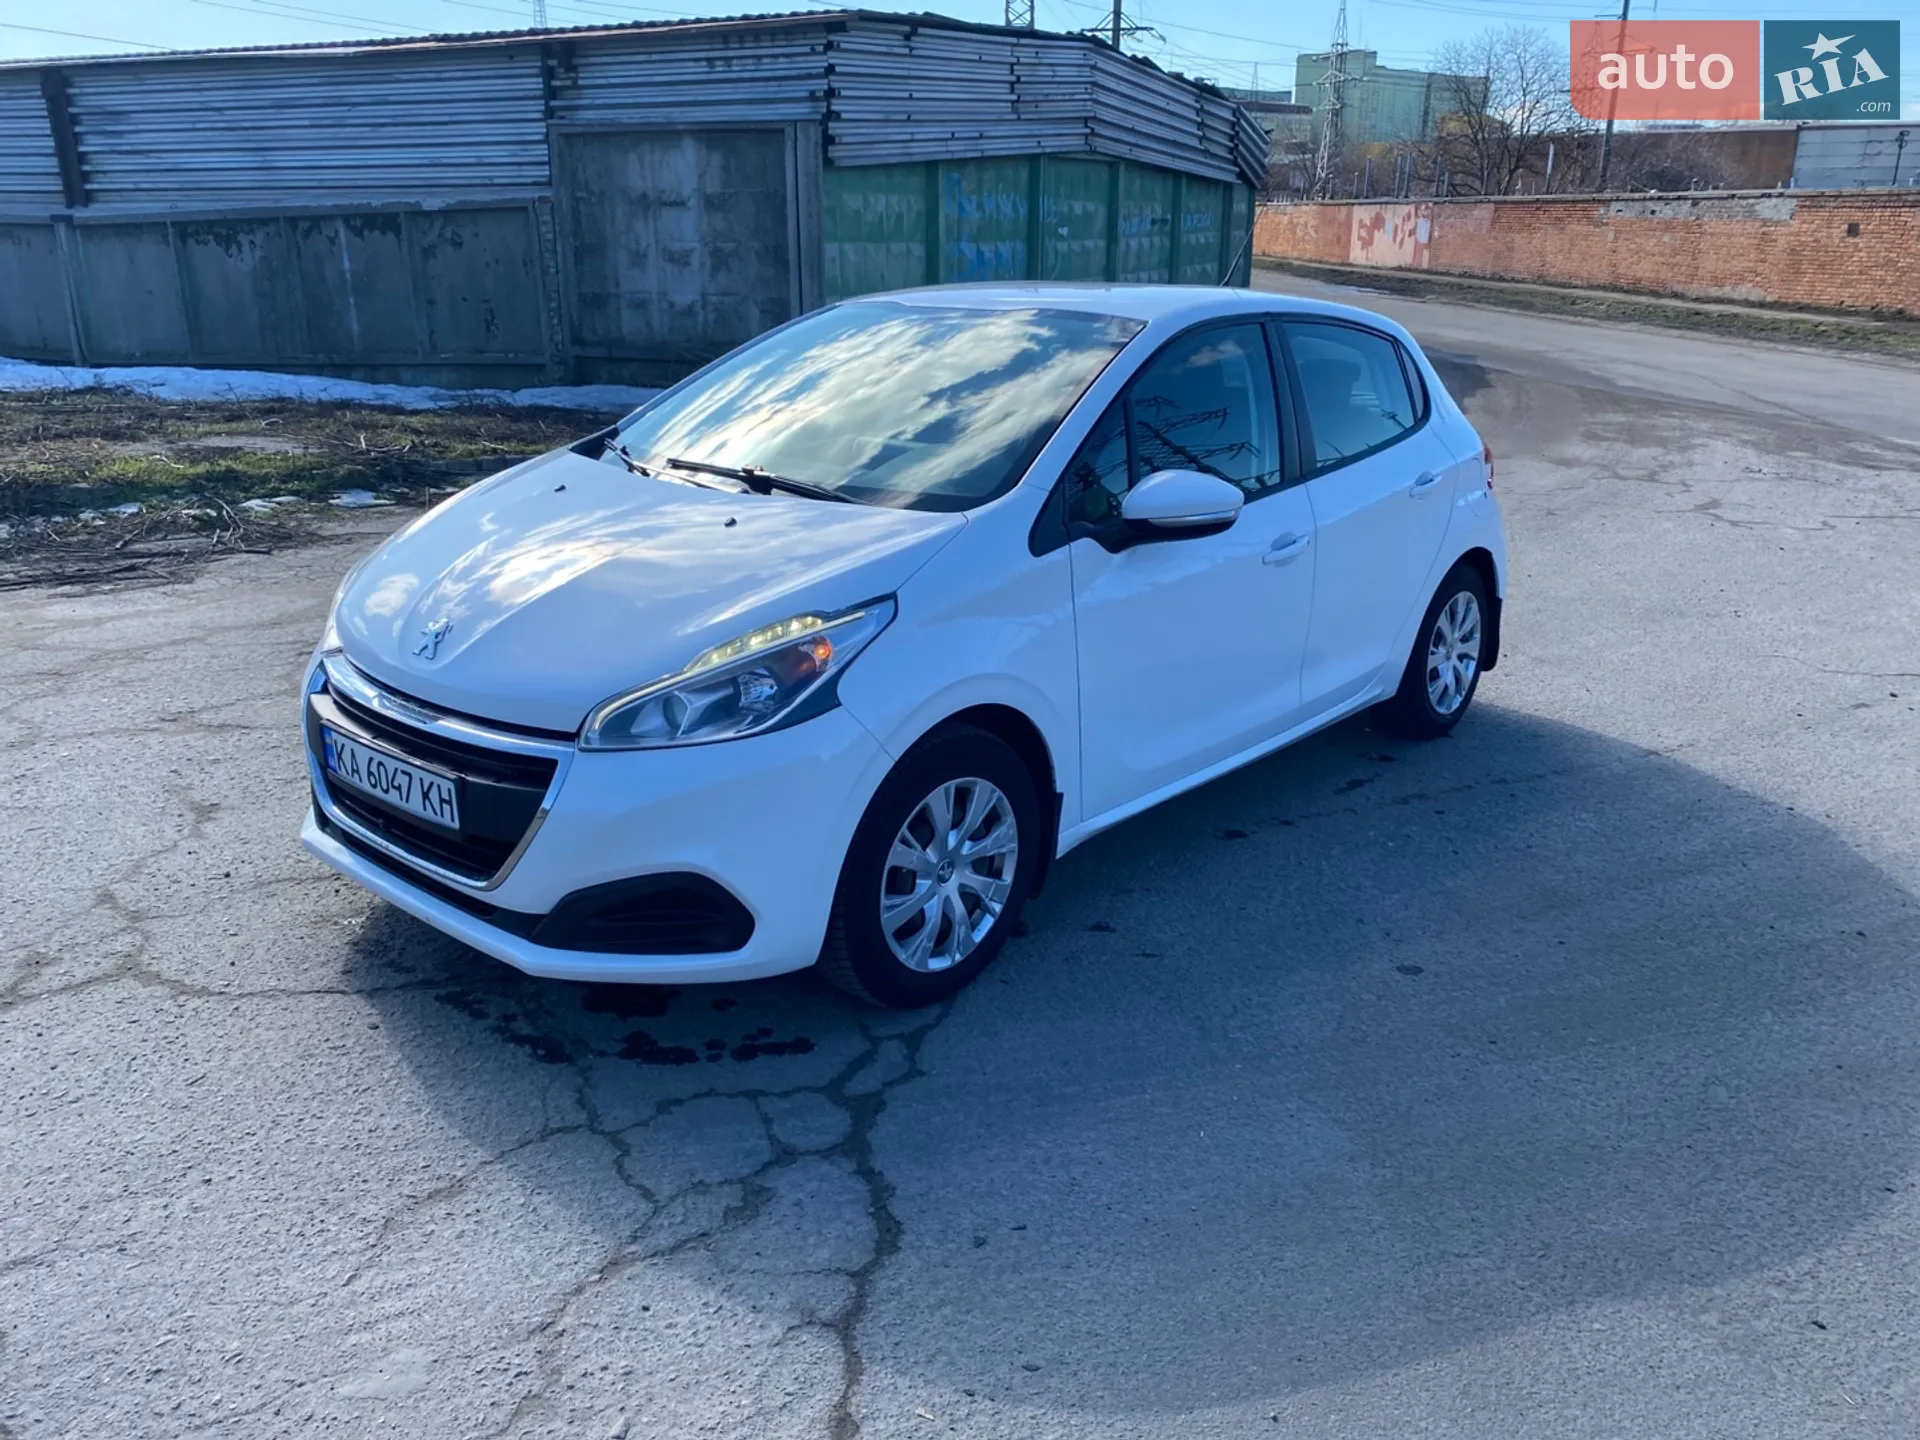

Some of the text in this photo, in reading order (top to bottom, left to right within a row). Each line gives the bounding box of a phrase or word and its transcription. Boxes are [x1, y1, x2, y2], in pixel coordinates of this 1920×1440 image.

[334, 739, 455, 823] KA 6047 KH
